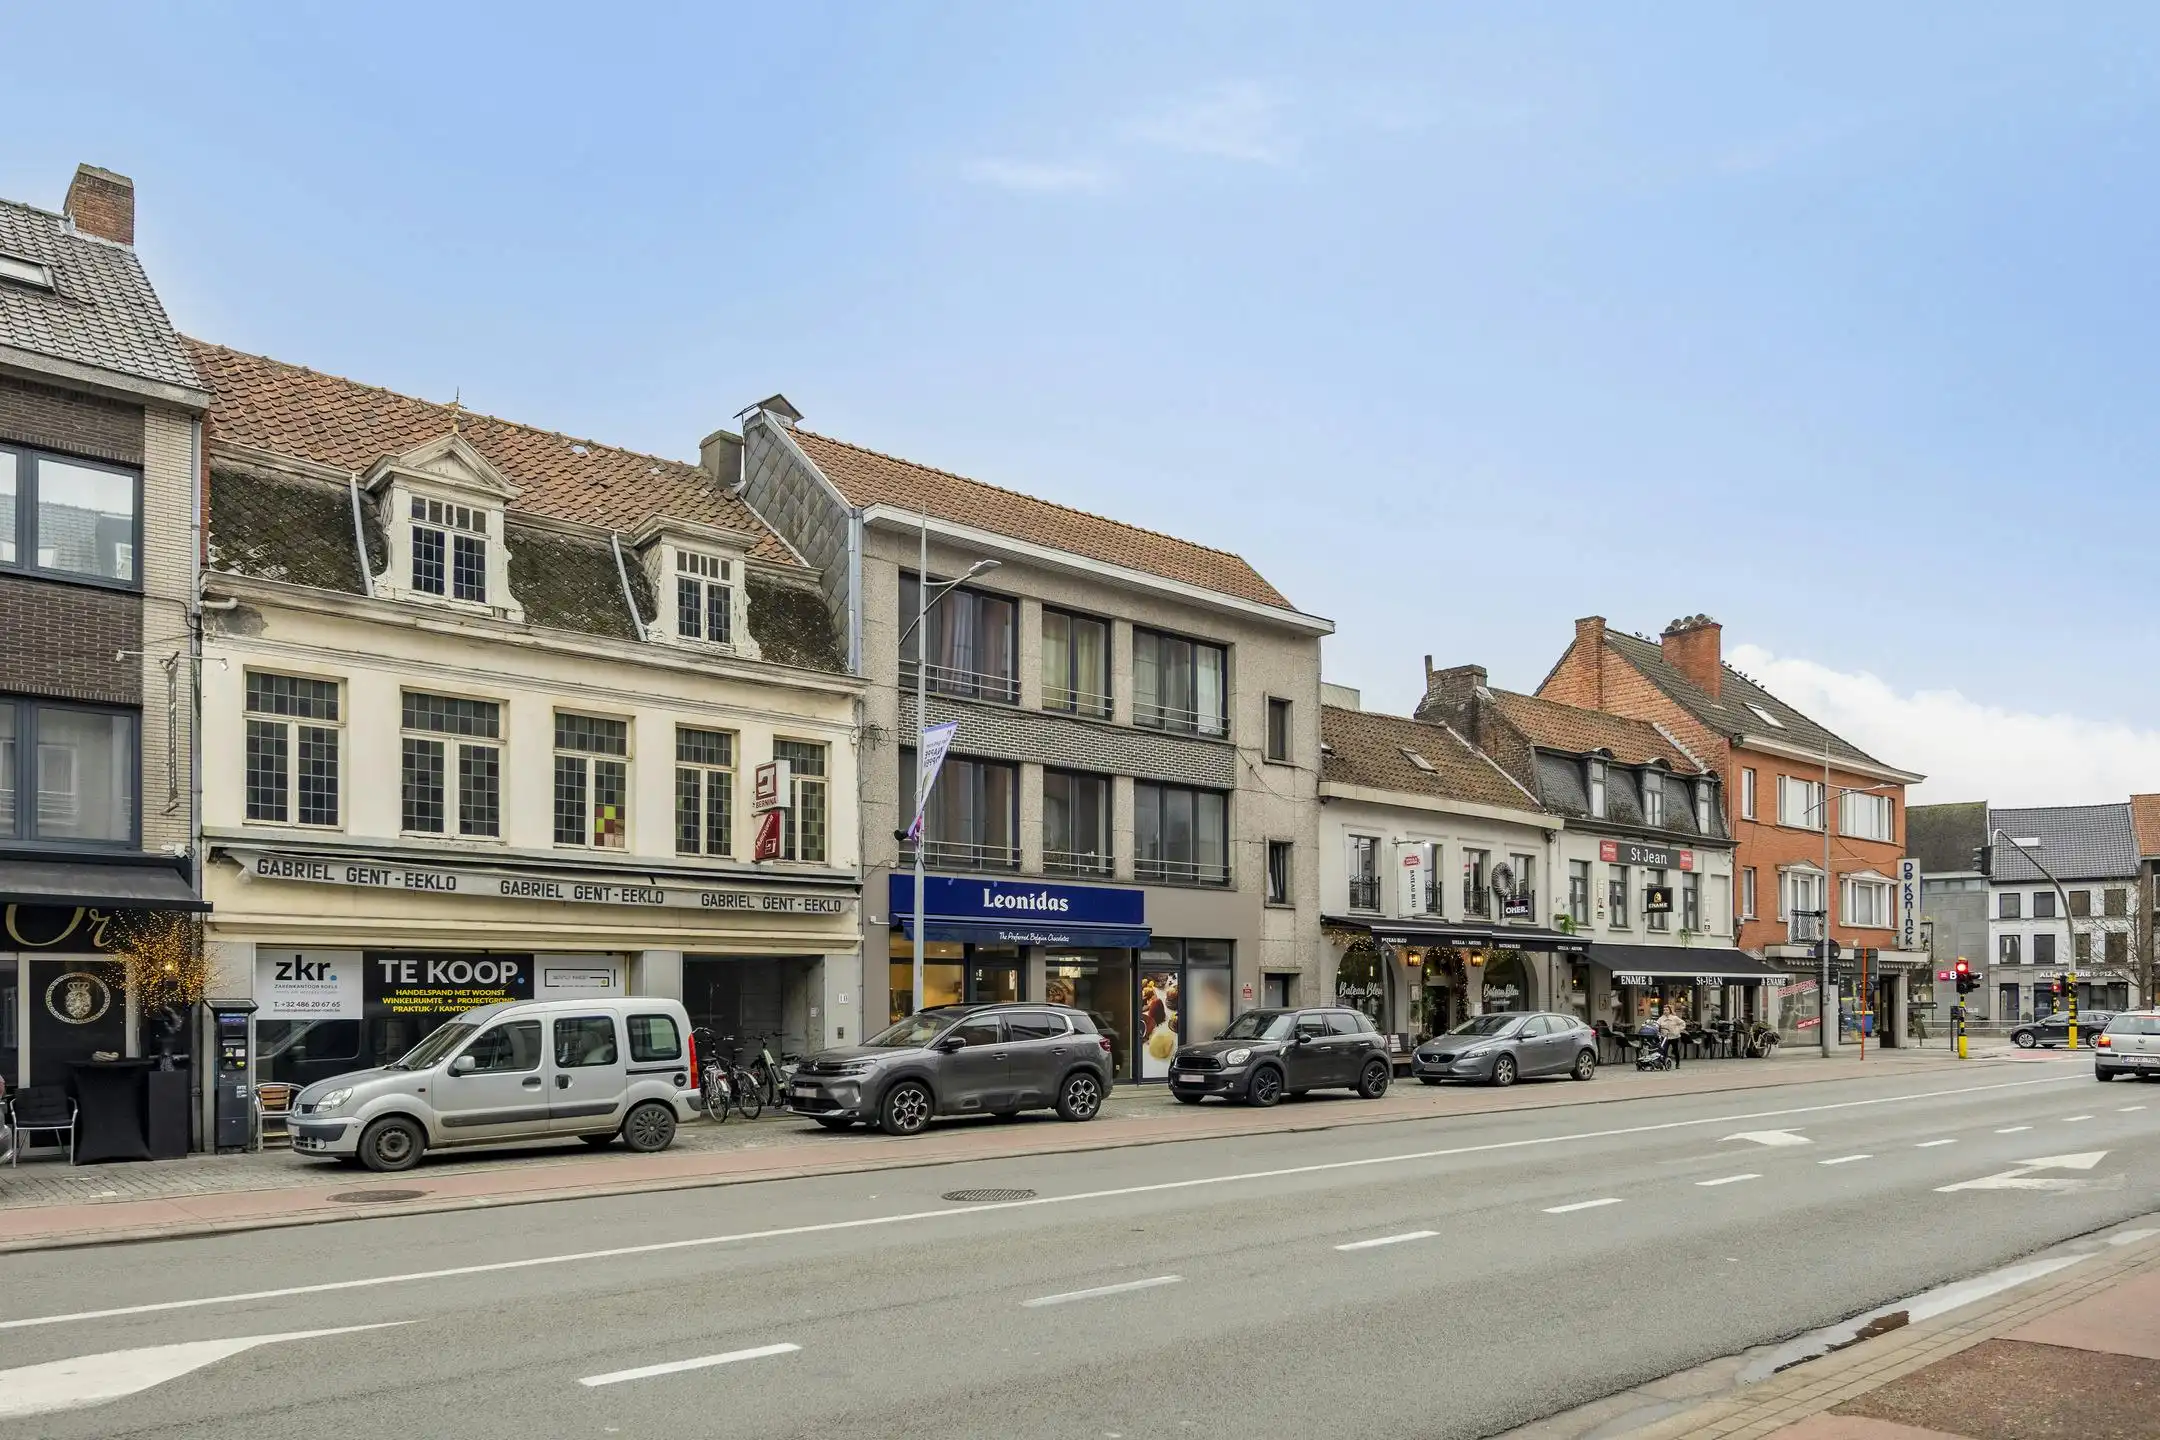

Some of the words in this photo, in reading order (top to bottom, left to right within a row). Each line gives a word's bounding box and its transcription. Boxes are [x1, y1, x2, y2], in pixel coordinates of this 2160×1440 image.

[756, 797, 777, 809] BERNINA
[1631, 847, 1640, 862] St
[1643, 849, 1667, 865] Jean
[256, 858, 335, 881] GABRIEL
[500, 880, 564, 899] GABRIEL
[701, 893, 755, 909] GABRIEL
[983, 888, 1069, 912] Leonidas
[378, 959, 418, 984] TE
[1621, 975, 1646, 985] ENAME
[471, 989, 506, 997] WOONST
